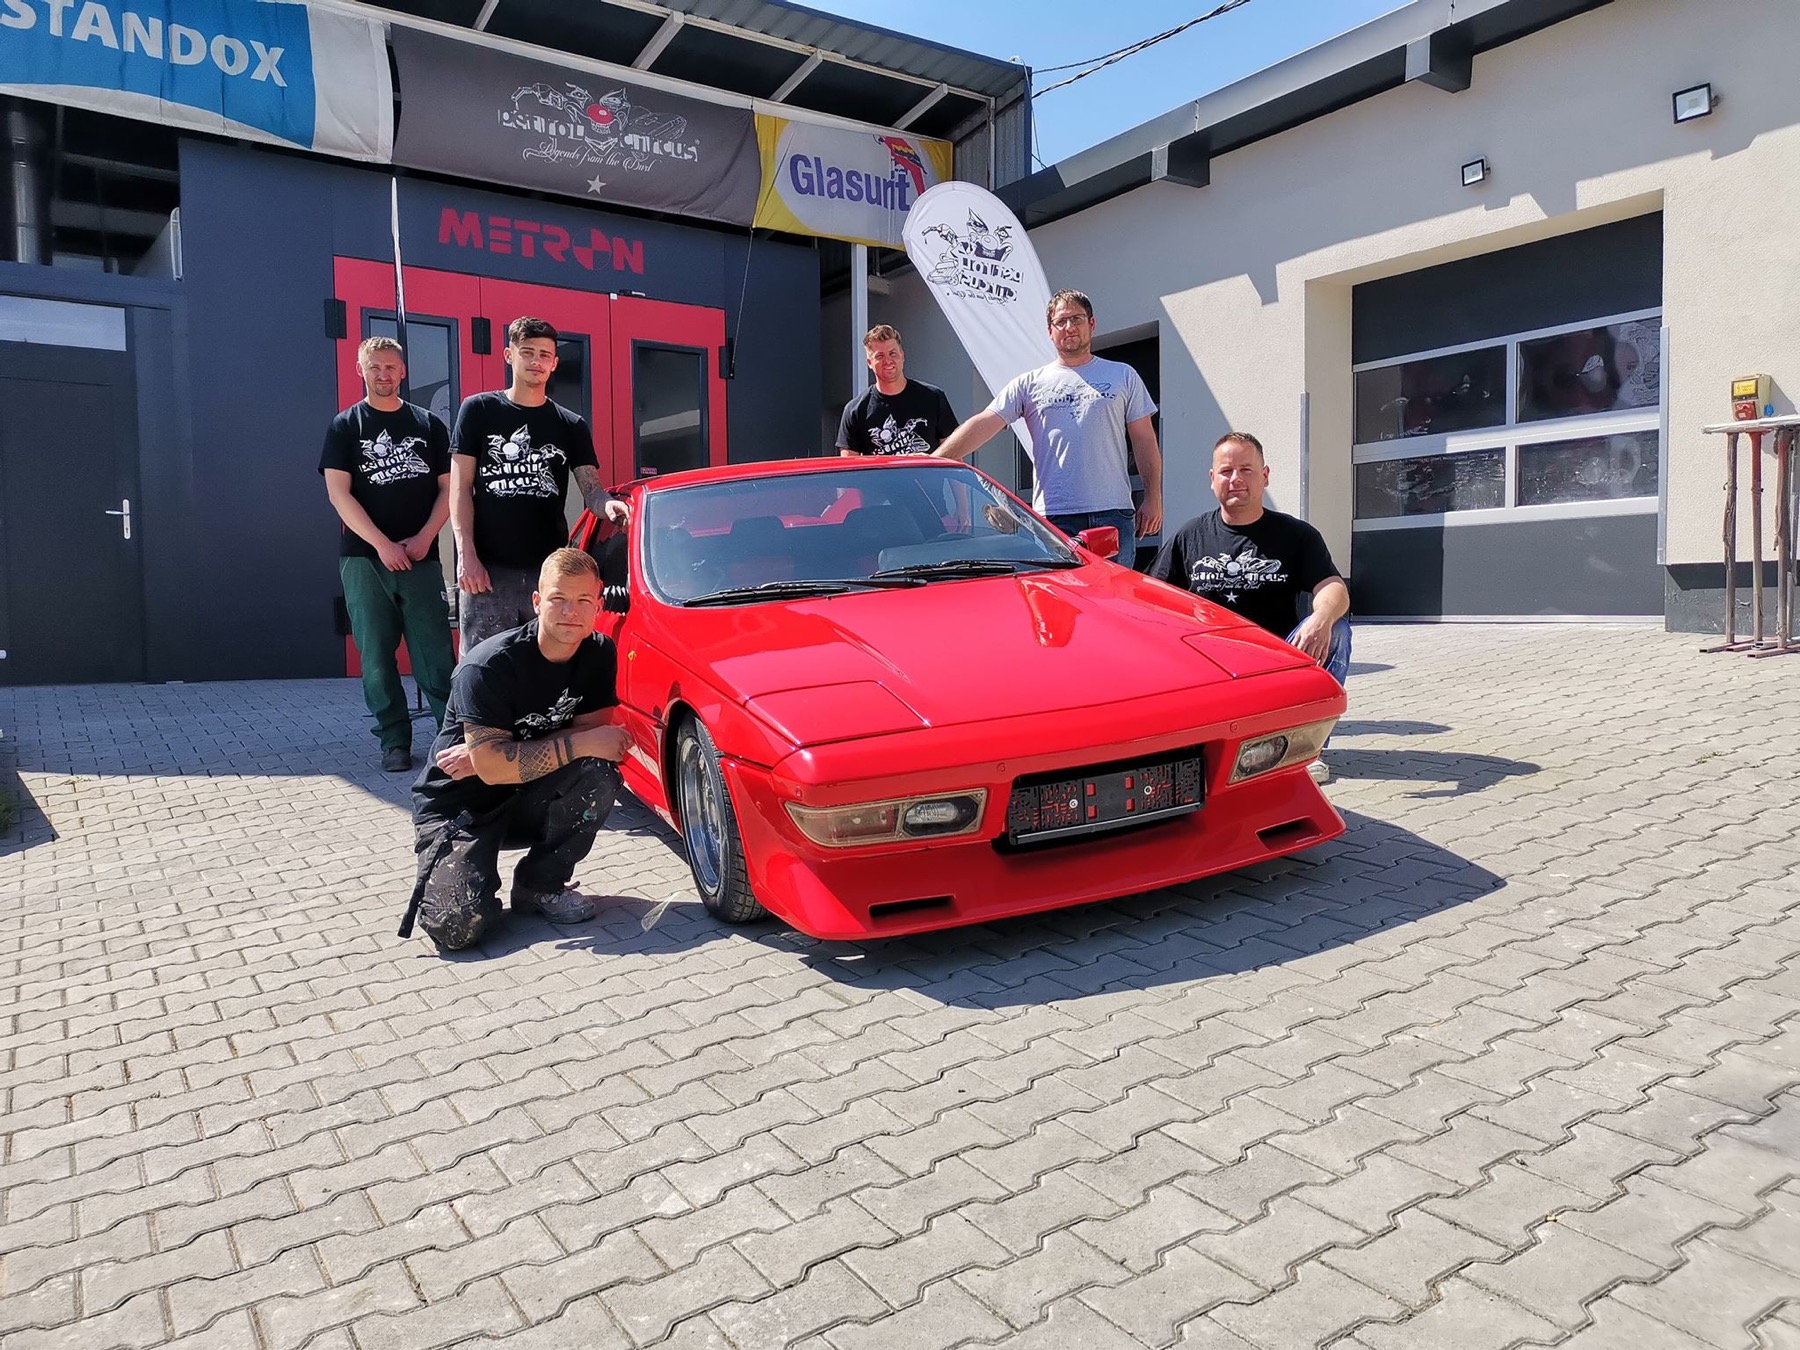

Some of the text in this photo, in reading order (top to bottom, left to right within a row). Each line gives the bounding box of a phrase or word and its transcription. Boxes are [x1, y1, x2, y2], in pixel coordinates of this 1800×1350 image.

[0, 0, 288, 88] STANDOX
[605, 151, 623, 167] the
[789, 153, 910, 212] Glasurit
[438, 208, 645, 276] METRON
